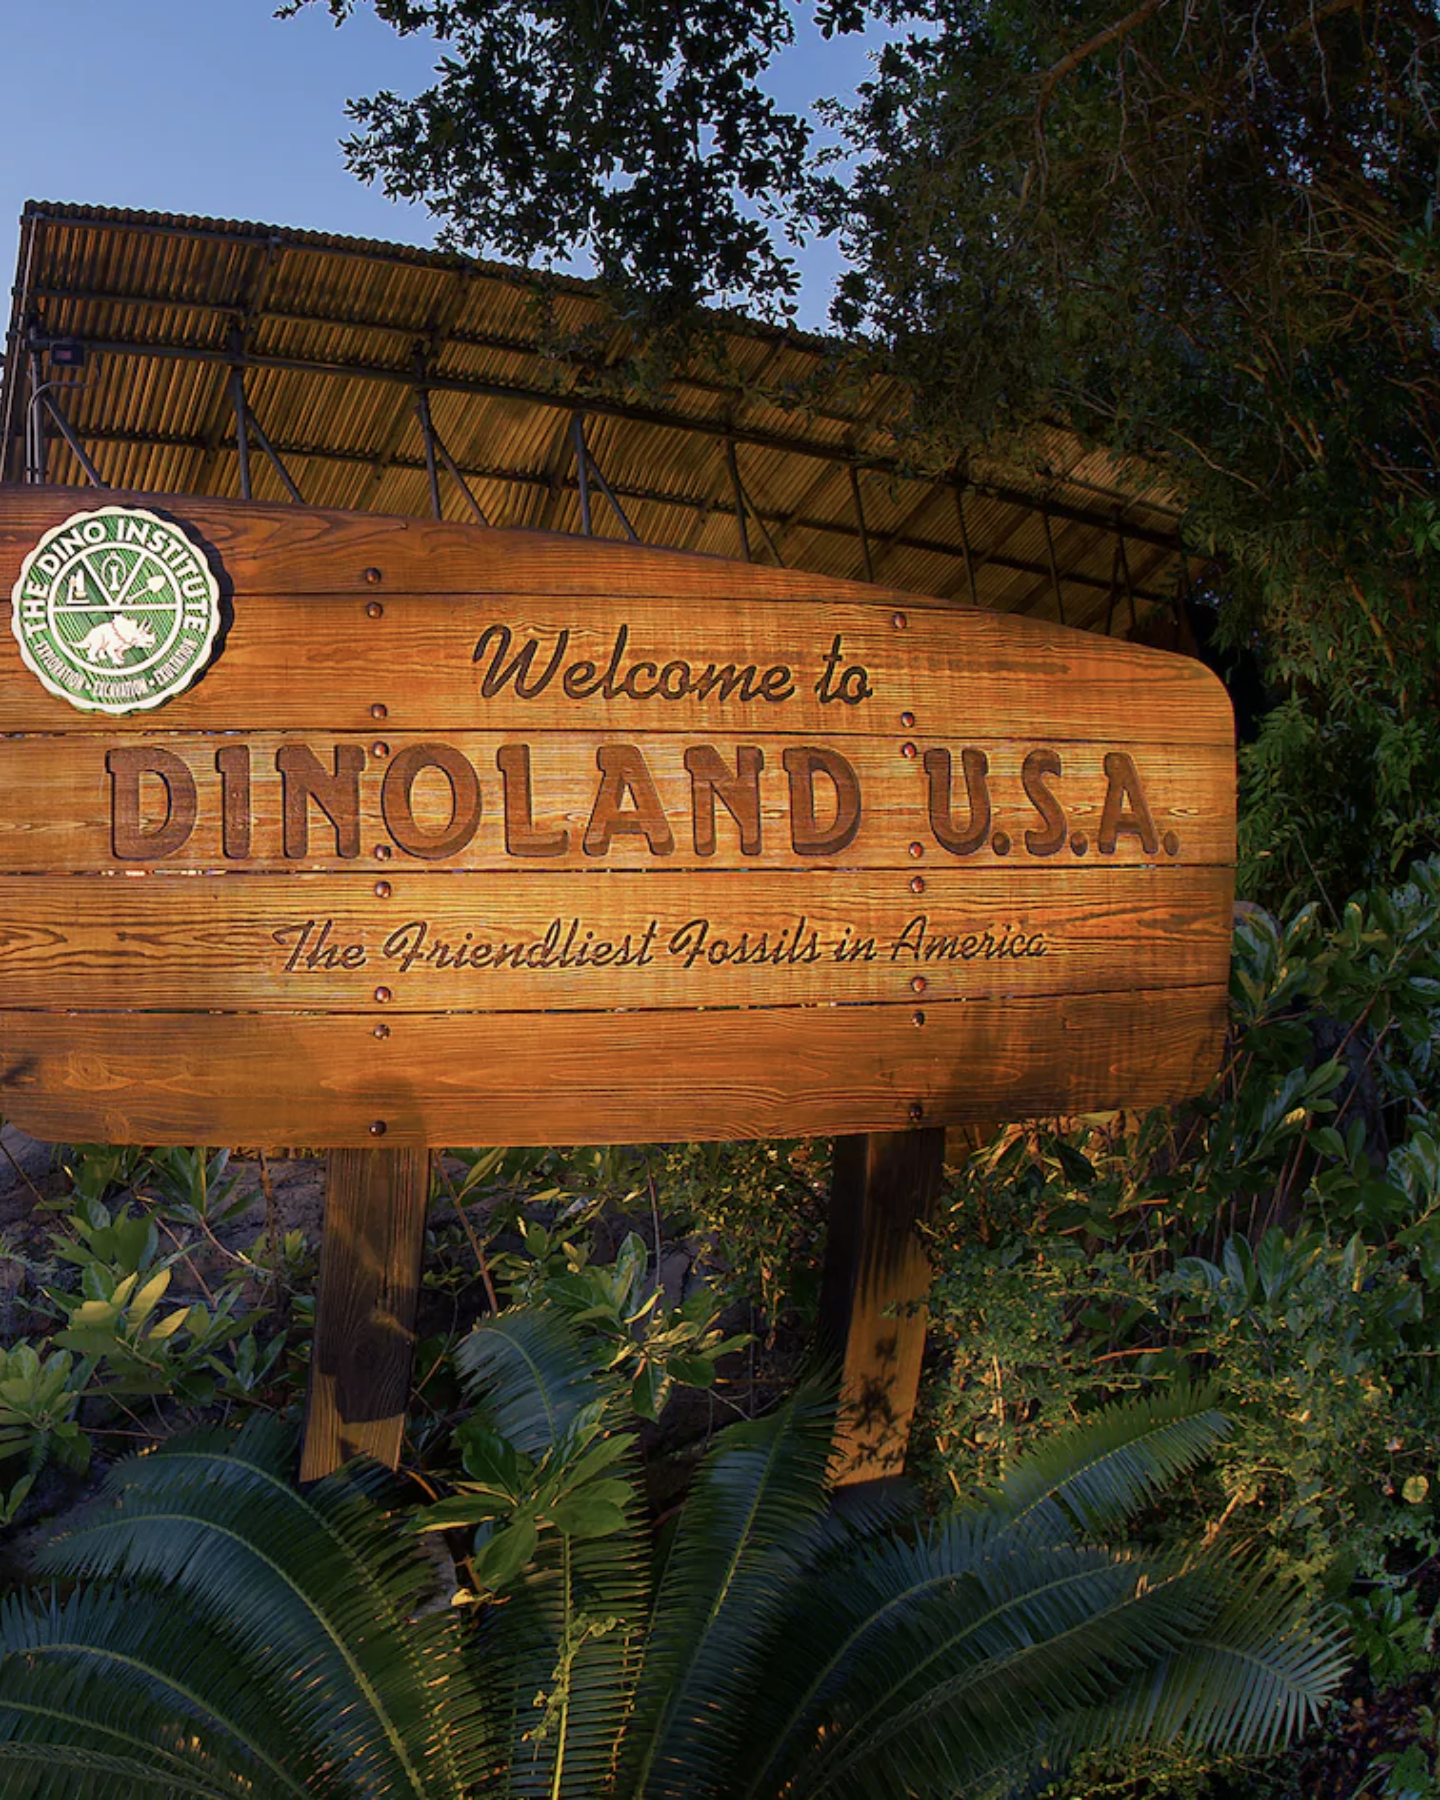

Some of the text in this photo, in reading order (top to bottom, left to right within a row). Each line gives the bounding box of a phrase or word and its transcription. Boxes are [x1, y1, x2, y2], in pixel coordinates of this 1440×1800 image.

[23, 519, 208, 639] THE DINO INSTITUTE
[472, 624, 874, 705] Welcome to
[105, 744, 1181, 860] DINOLAND U.S.A.
[272, 915, 1047, 972] The Friendliest Fossils in America
